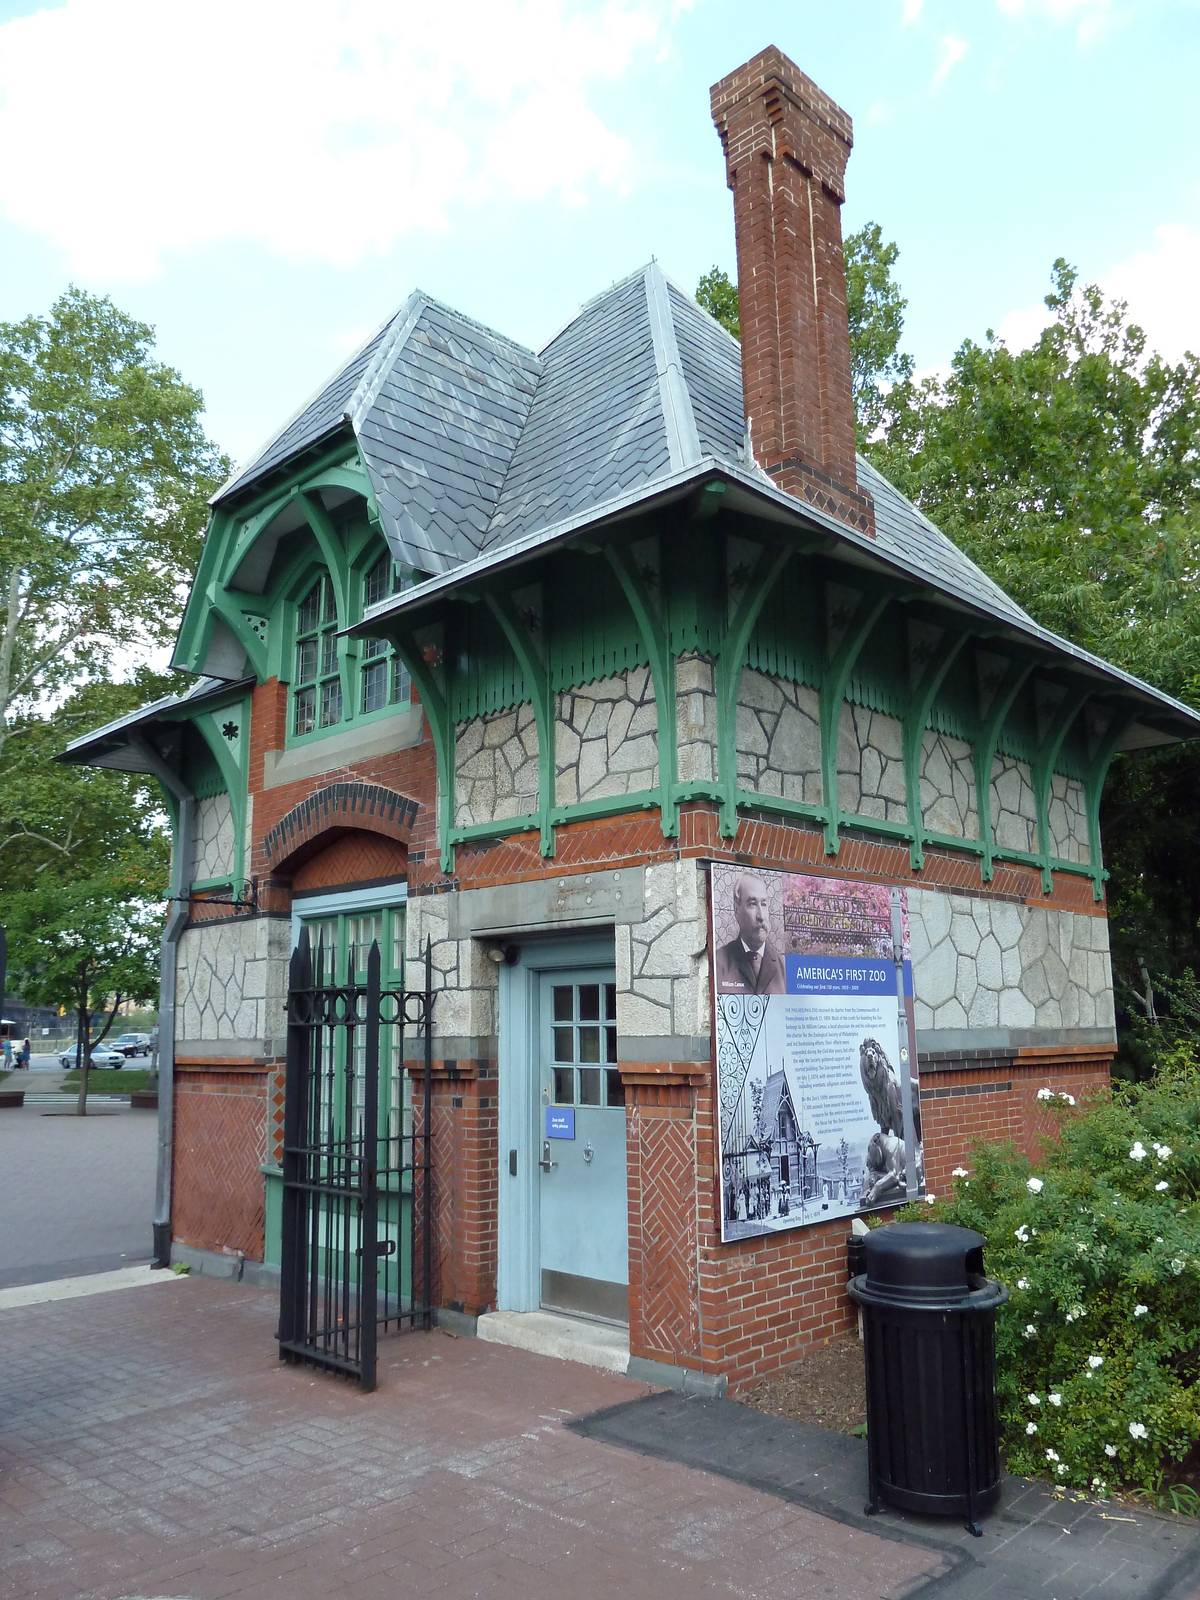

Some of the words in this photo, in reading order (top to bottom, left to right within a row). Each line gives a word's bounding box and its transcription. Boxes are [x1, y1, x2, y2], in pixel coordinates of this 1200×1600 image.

[796, 966, 843, 981] AMERICA'S
[845, 969, 867, 982] FIRST
[869, 970, 886, 982] ZOO
